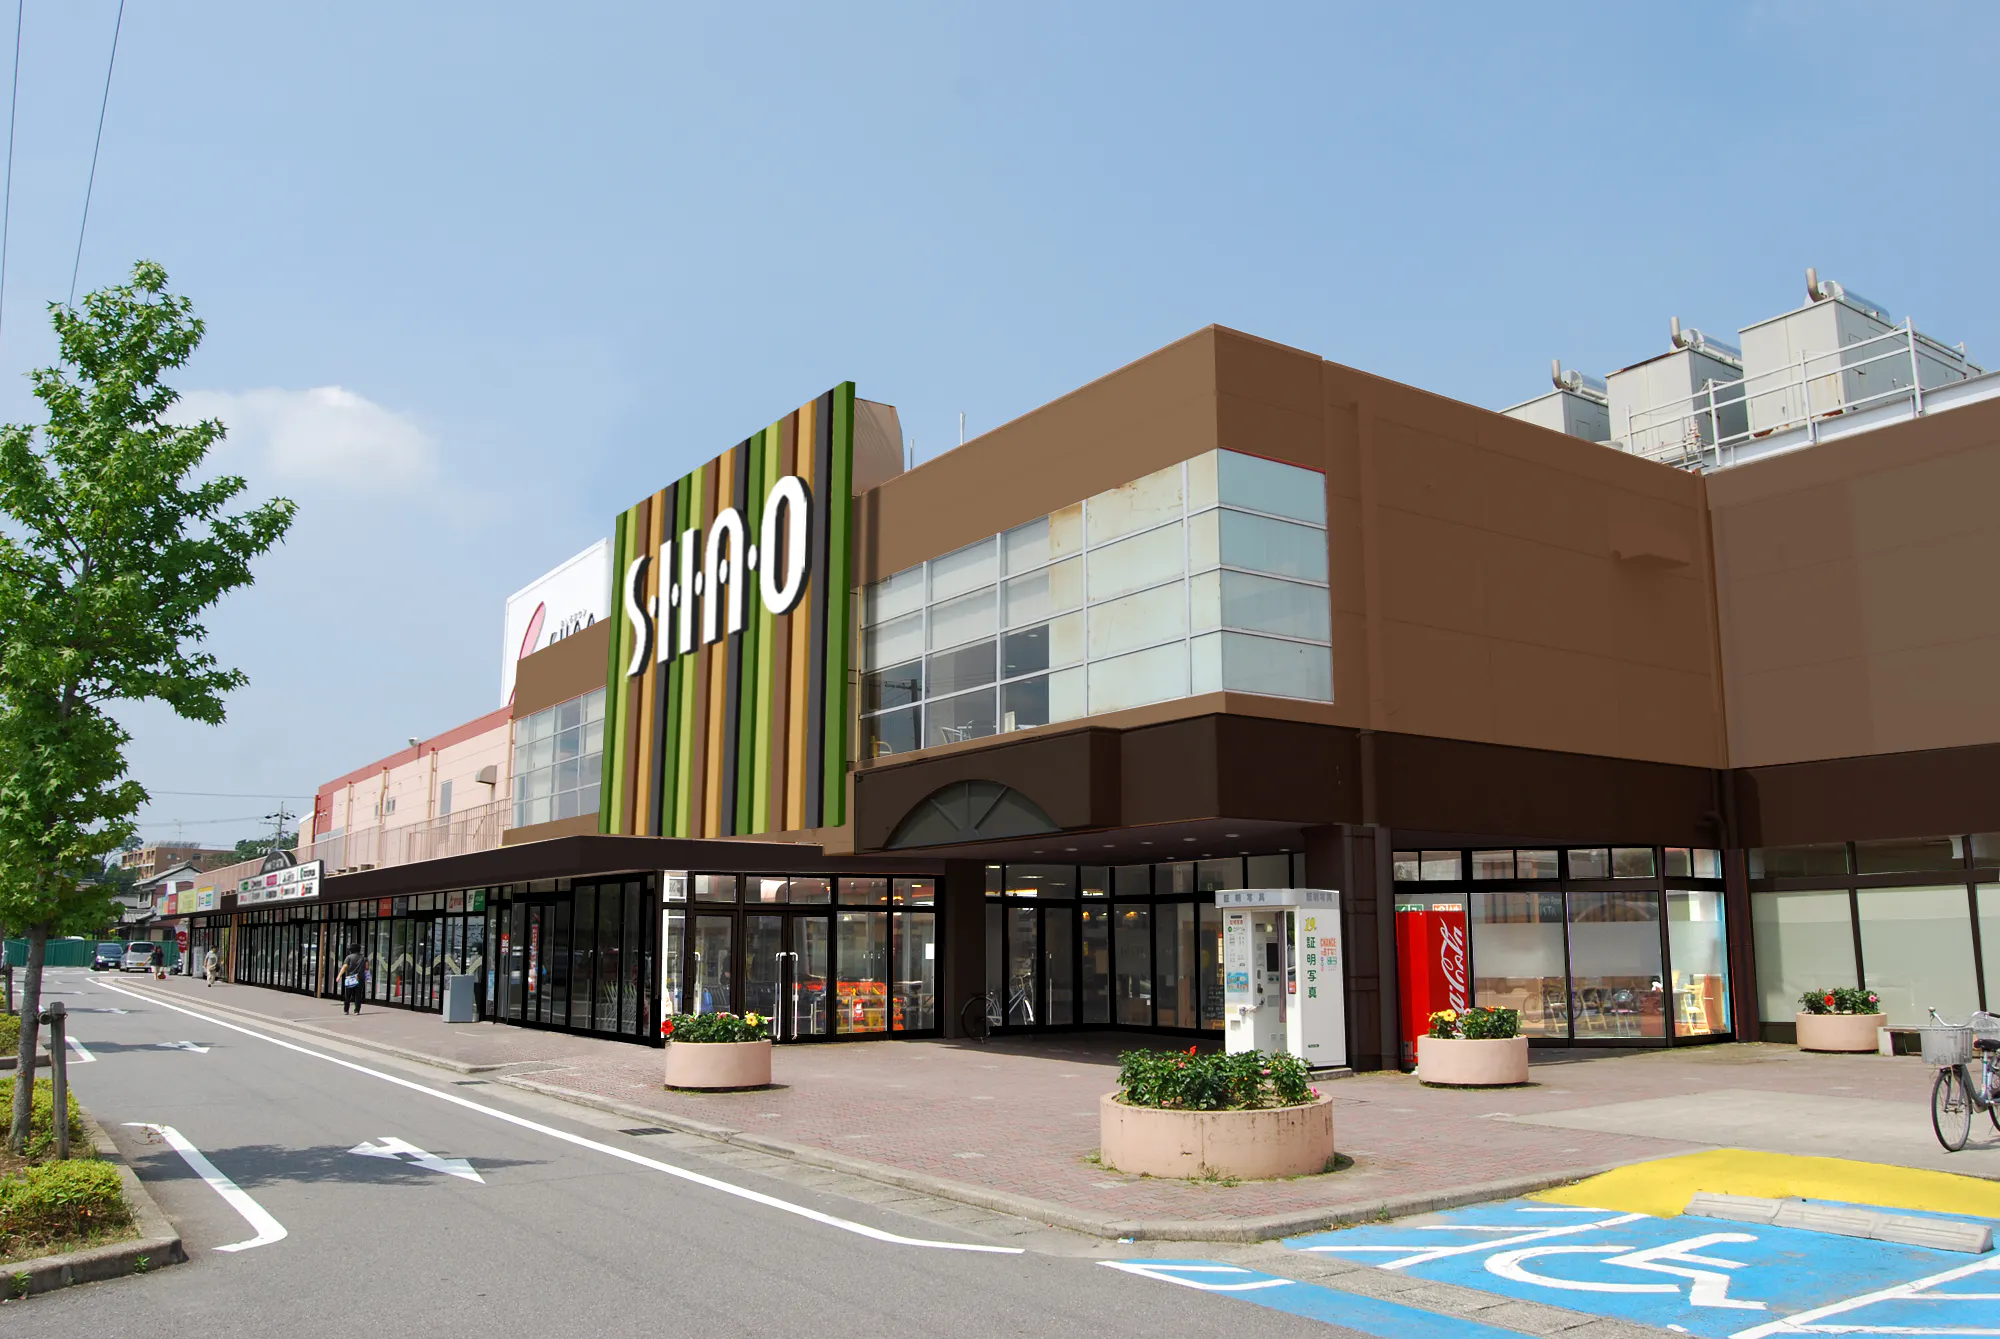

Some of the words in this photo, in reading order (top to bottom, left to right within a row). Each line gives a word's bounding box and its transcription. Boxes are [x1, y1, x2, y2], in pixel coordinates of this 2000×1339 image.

[1223, 893, 1265, 903] 証明写真
[1306, 936, 1317, 998] 証明写真
[1439, 916, 1466, 1037] a-Cola
